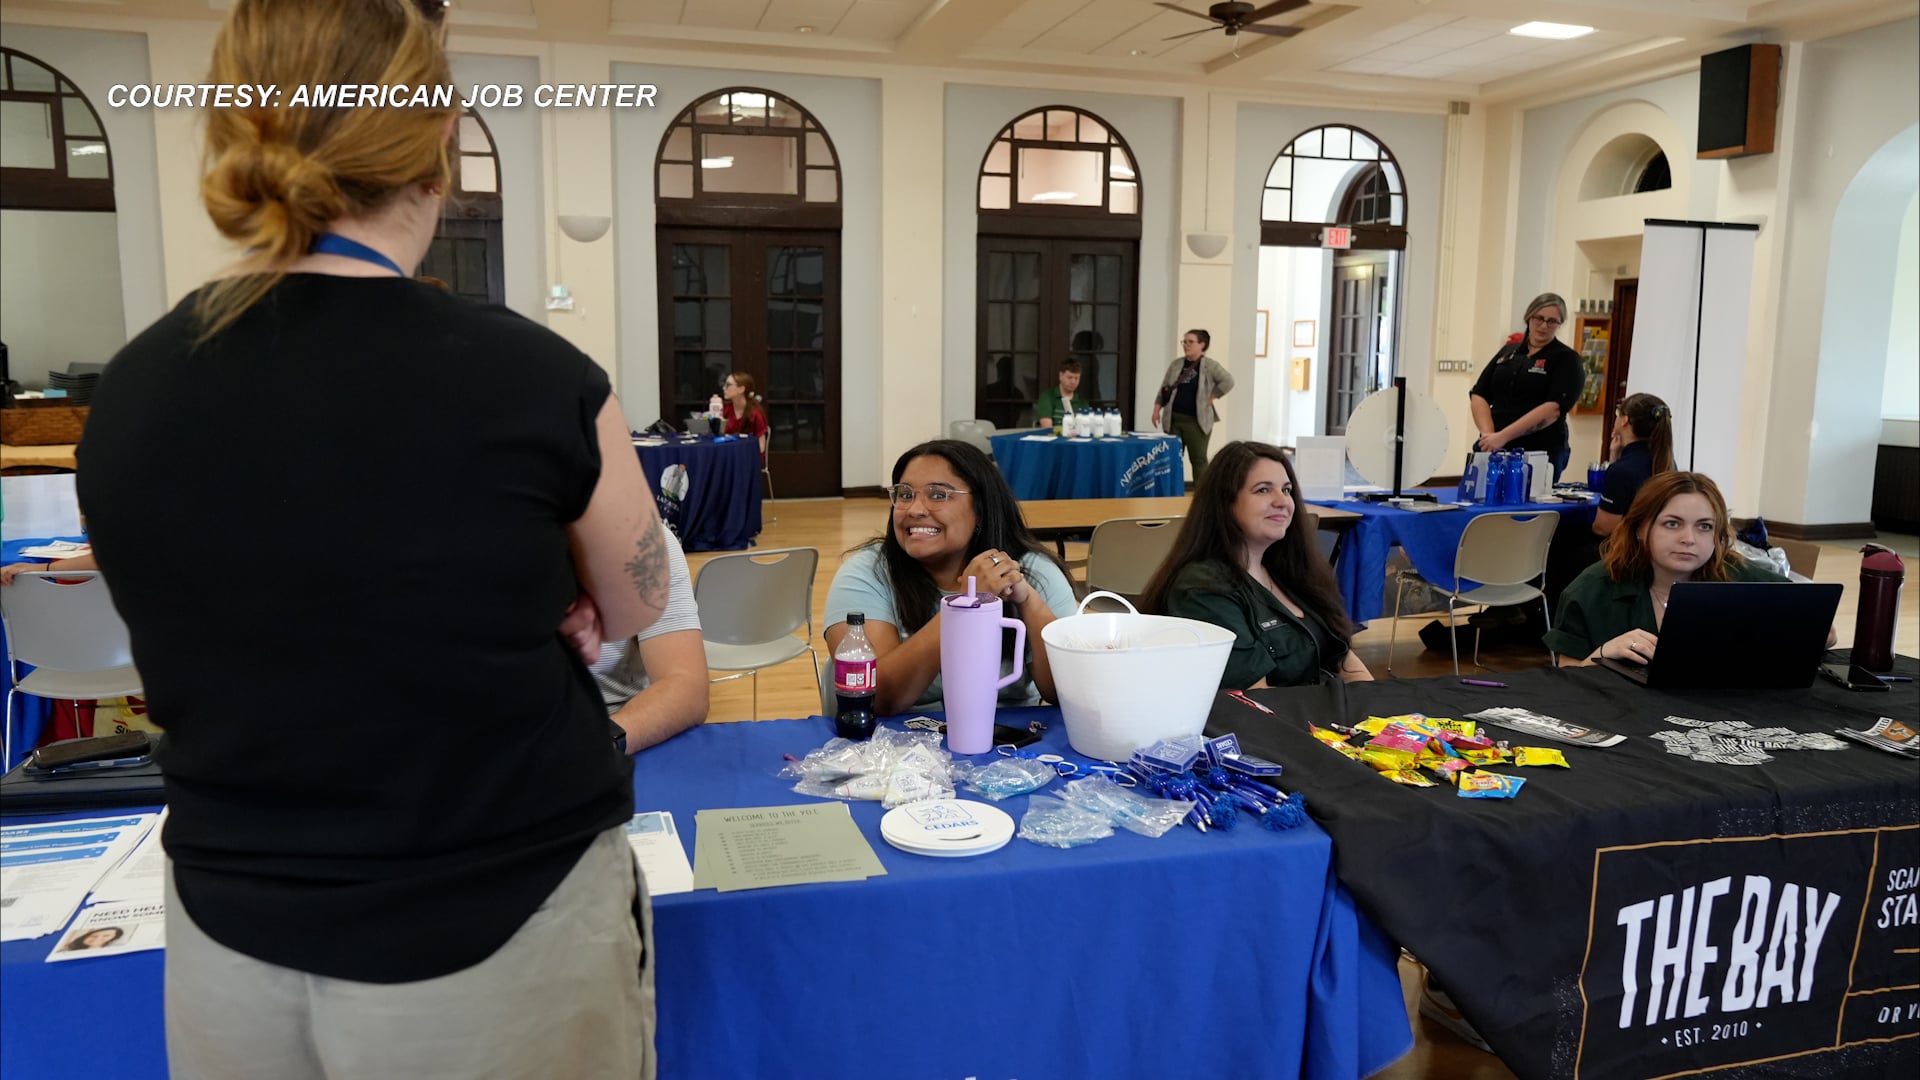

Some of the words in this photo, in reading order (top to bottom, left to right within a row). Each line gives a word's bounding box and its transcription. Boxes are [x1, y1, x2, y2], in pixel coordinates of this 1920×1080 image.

[1328, 228, 1348, 246] EXIT
[724, 813, 763, 822] WELCOME
[924, 820, 979, 831] CEDARS
[93, 908, 129, 918] NEED
[1617, 876, 1732, 1029] THE
[1721, 875, 1841, 1013] BAY
[1878, 1006, 1901, 1024] OR
[1675, 1027, 1705, 1048] EST.
[1711, 1021, 1748, 1041] 2010
